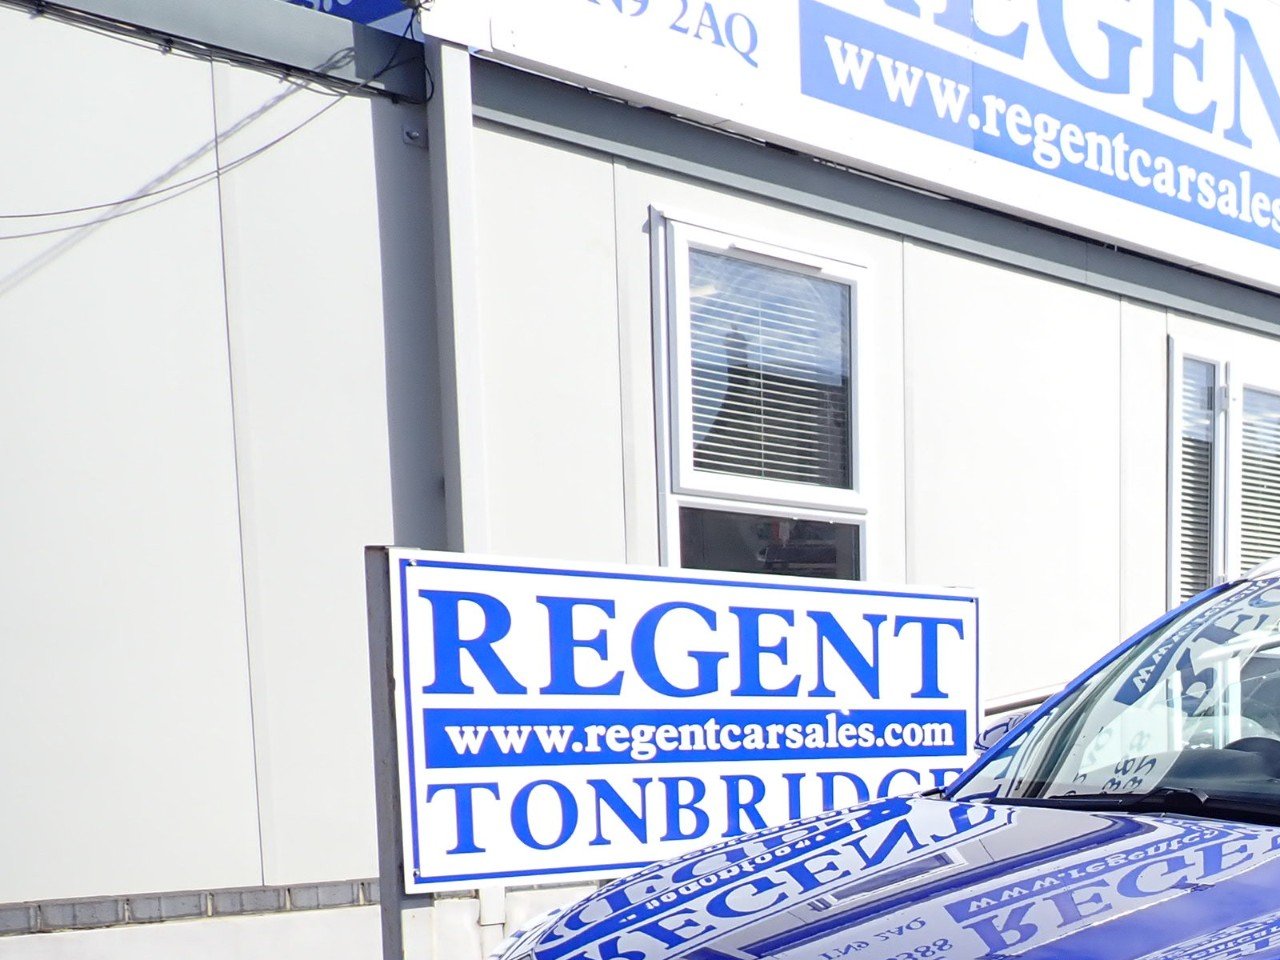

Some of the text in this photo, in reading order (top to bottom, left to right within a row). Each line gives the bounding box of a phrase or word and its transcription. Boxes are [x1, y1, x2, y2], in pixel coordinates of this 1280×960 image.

[668, 0, 759, 68] 2AQ
[418, 588, 965, 701] REGENT
[444, 712, 955, 761] www.regentcarsales.com
